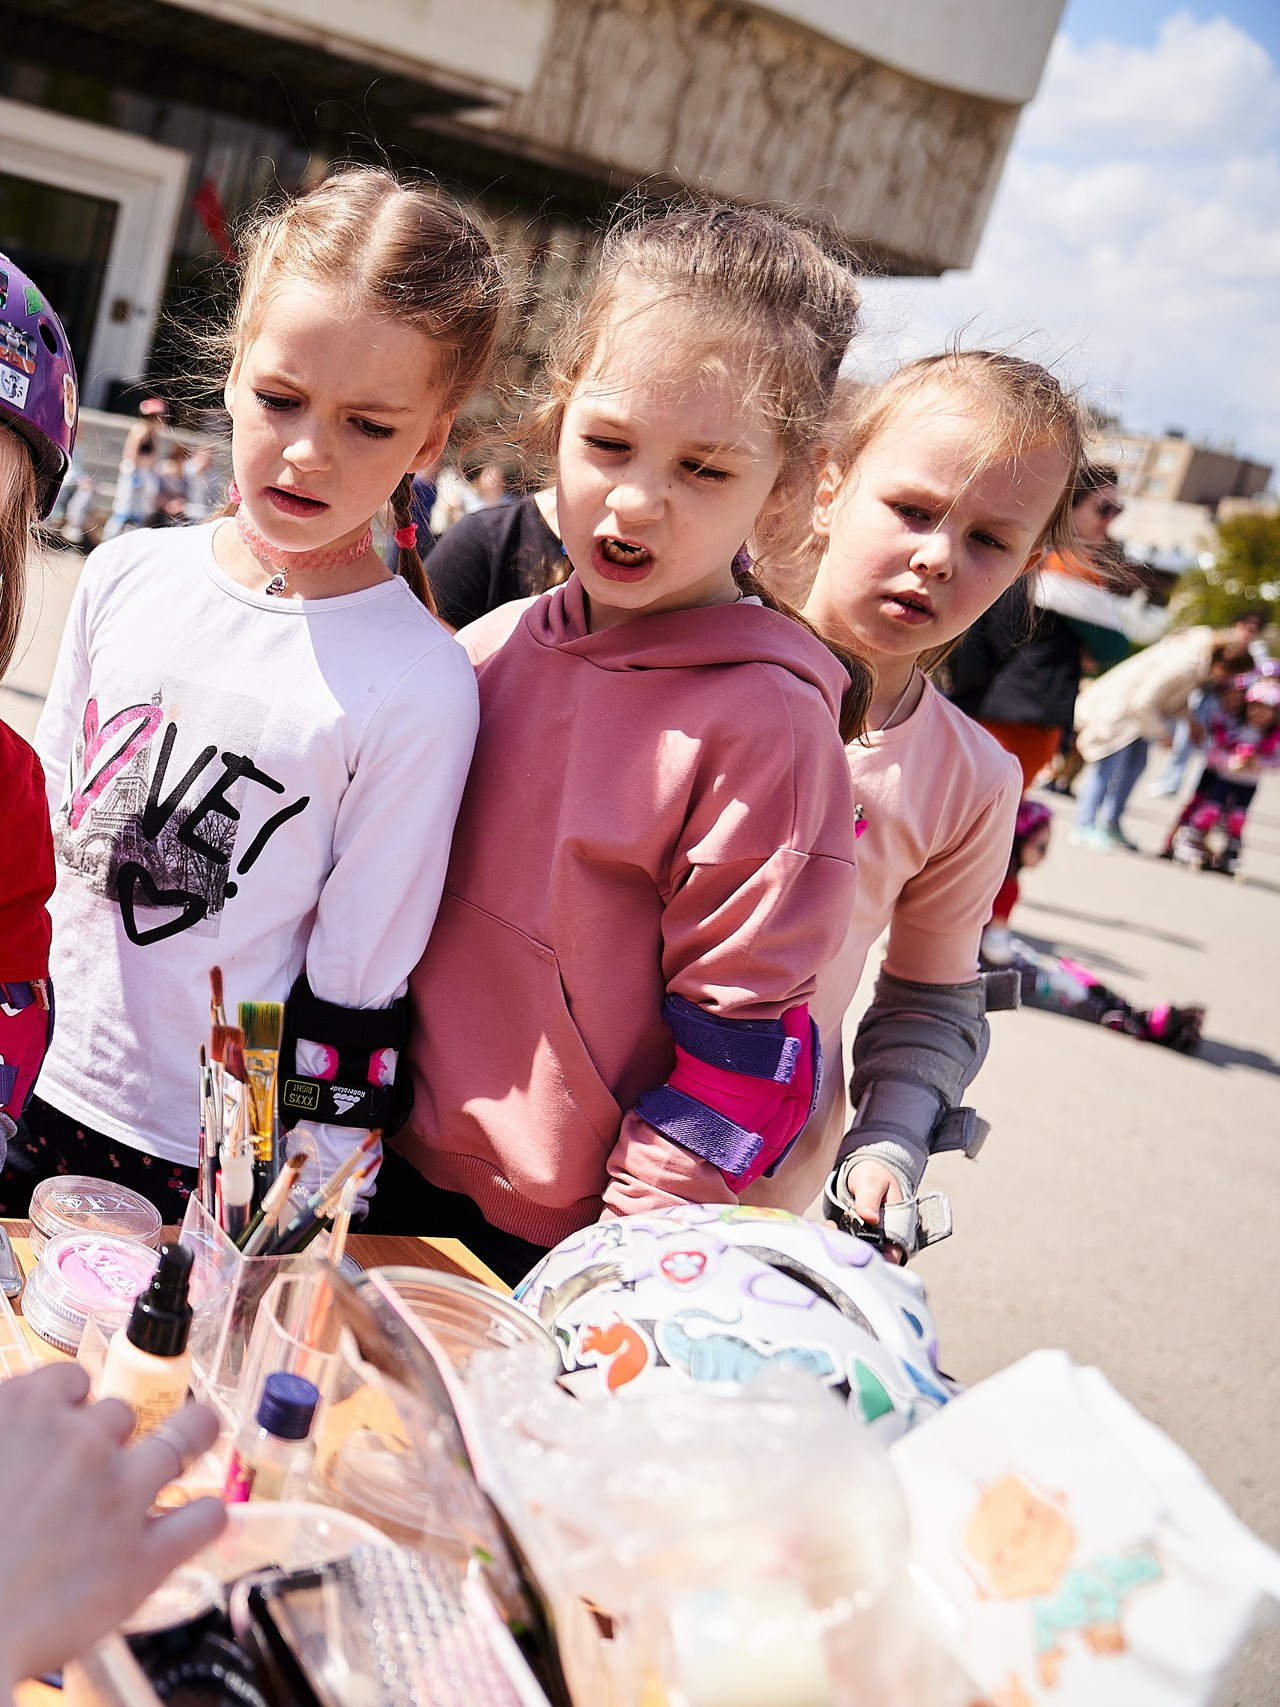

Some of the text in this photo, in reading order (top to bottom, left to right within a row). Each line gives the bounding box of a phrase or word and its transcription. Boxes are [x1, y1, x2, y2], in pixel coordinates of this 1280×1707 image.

[292, 1083, 313, 1094] RIGHT
[329, 1085, 366, 1098] Rollerblade
[289, 1093, 314, 1107] XXXS
